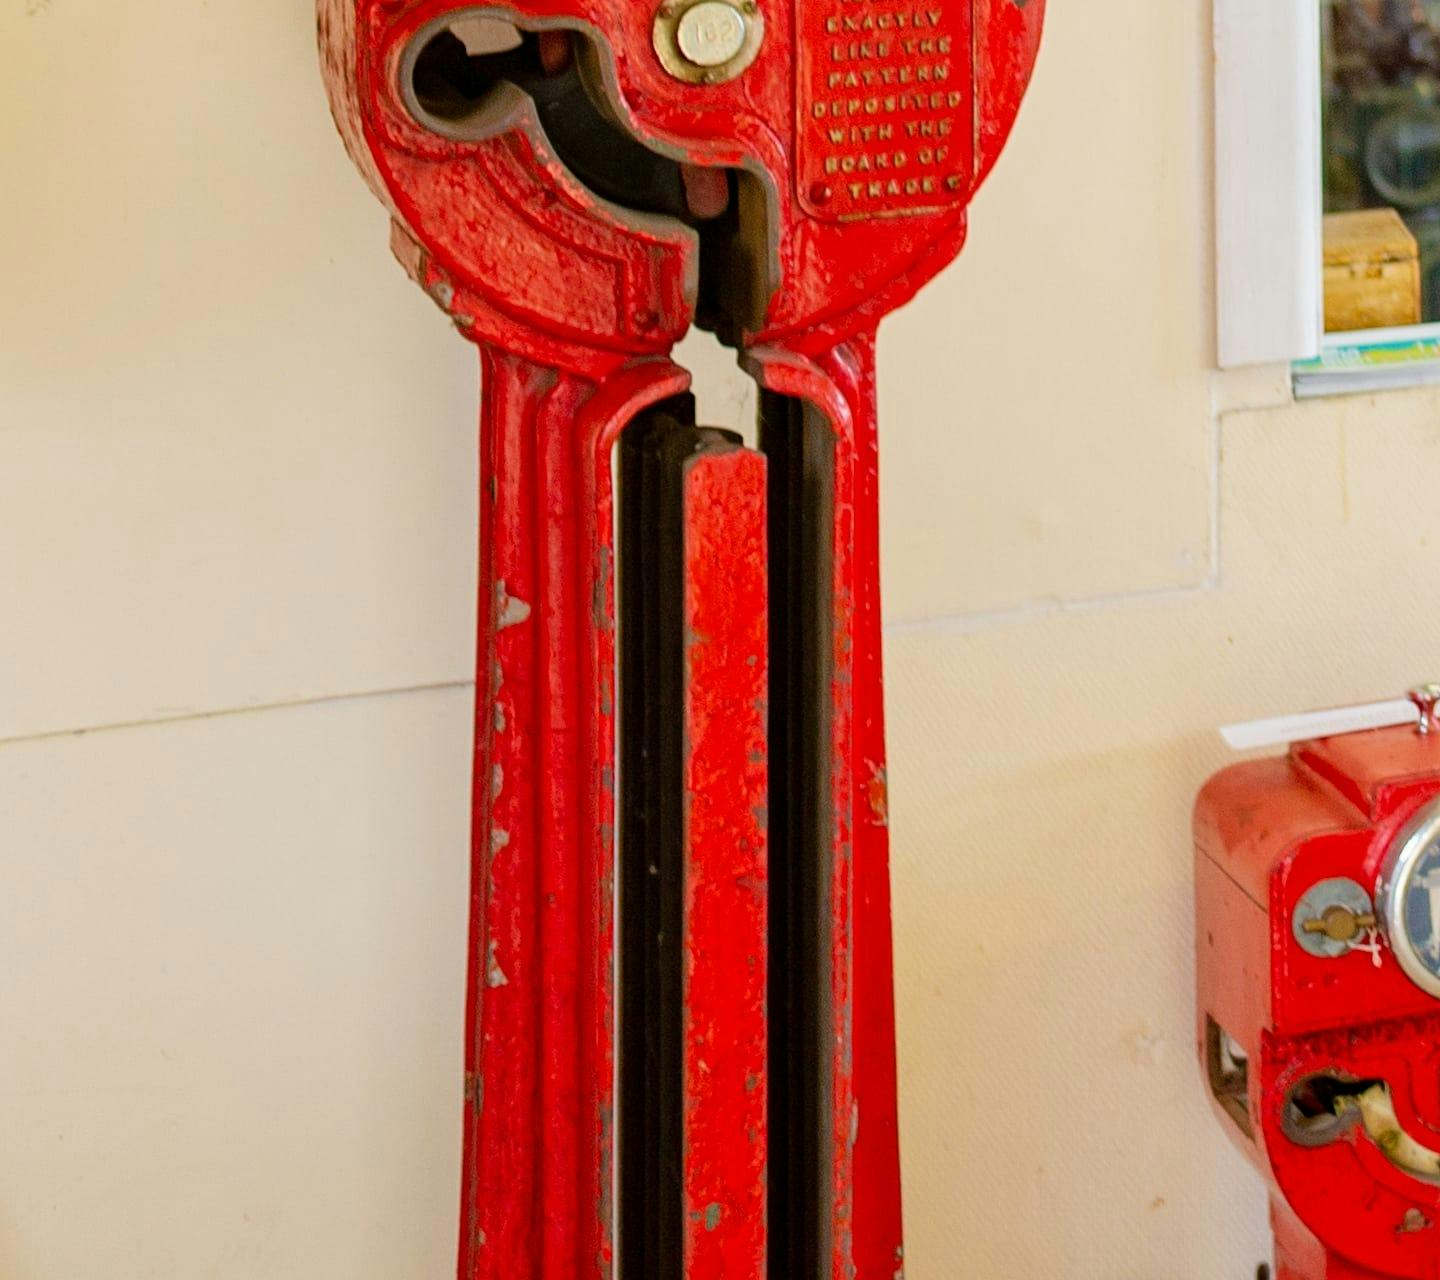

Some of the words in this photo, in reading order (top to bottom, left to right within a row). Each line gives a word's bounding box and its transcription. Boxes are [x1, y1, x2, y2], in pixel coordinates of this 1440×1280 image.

[826, 9, 943, 33] EXACTLY
[831, 39, 890, 62] LIKE
[903, 35, 952, 56] THE
[828, 65, 949, 89] PATTERN
[812, 91, 962, 119] DEPOSITED
[827, 122, 894, 145] WITH
[905, 117, 953, 139] THE
[825, 150, 907, 175] BOARD
[918, 146, 949, 166] OF
[849, 176, 935, 200] TRADE
